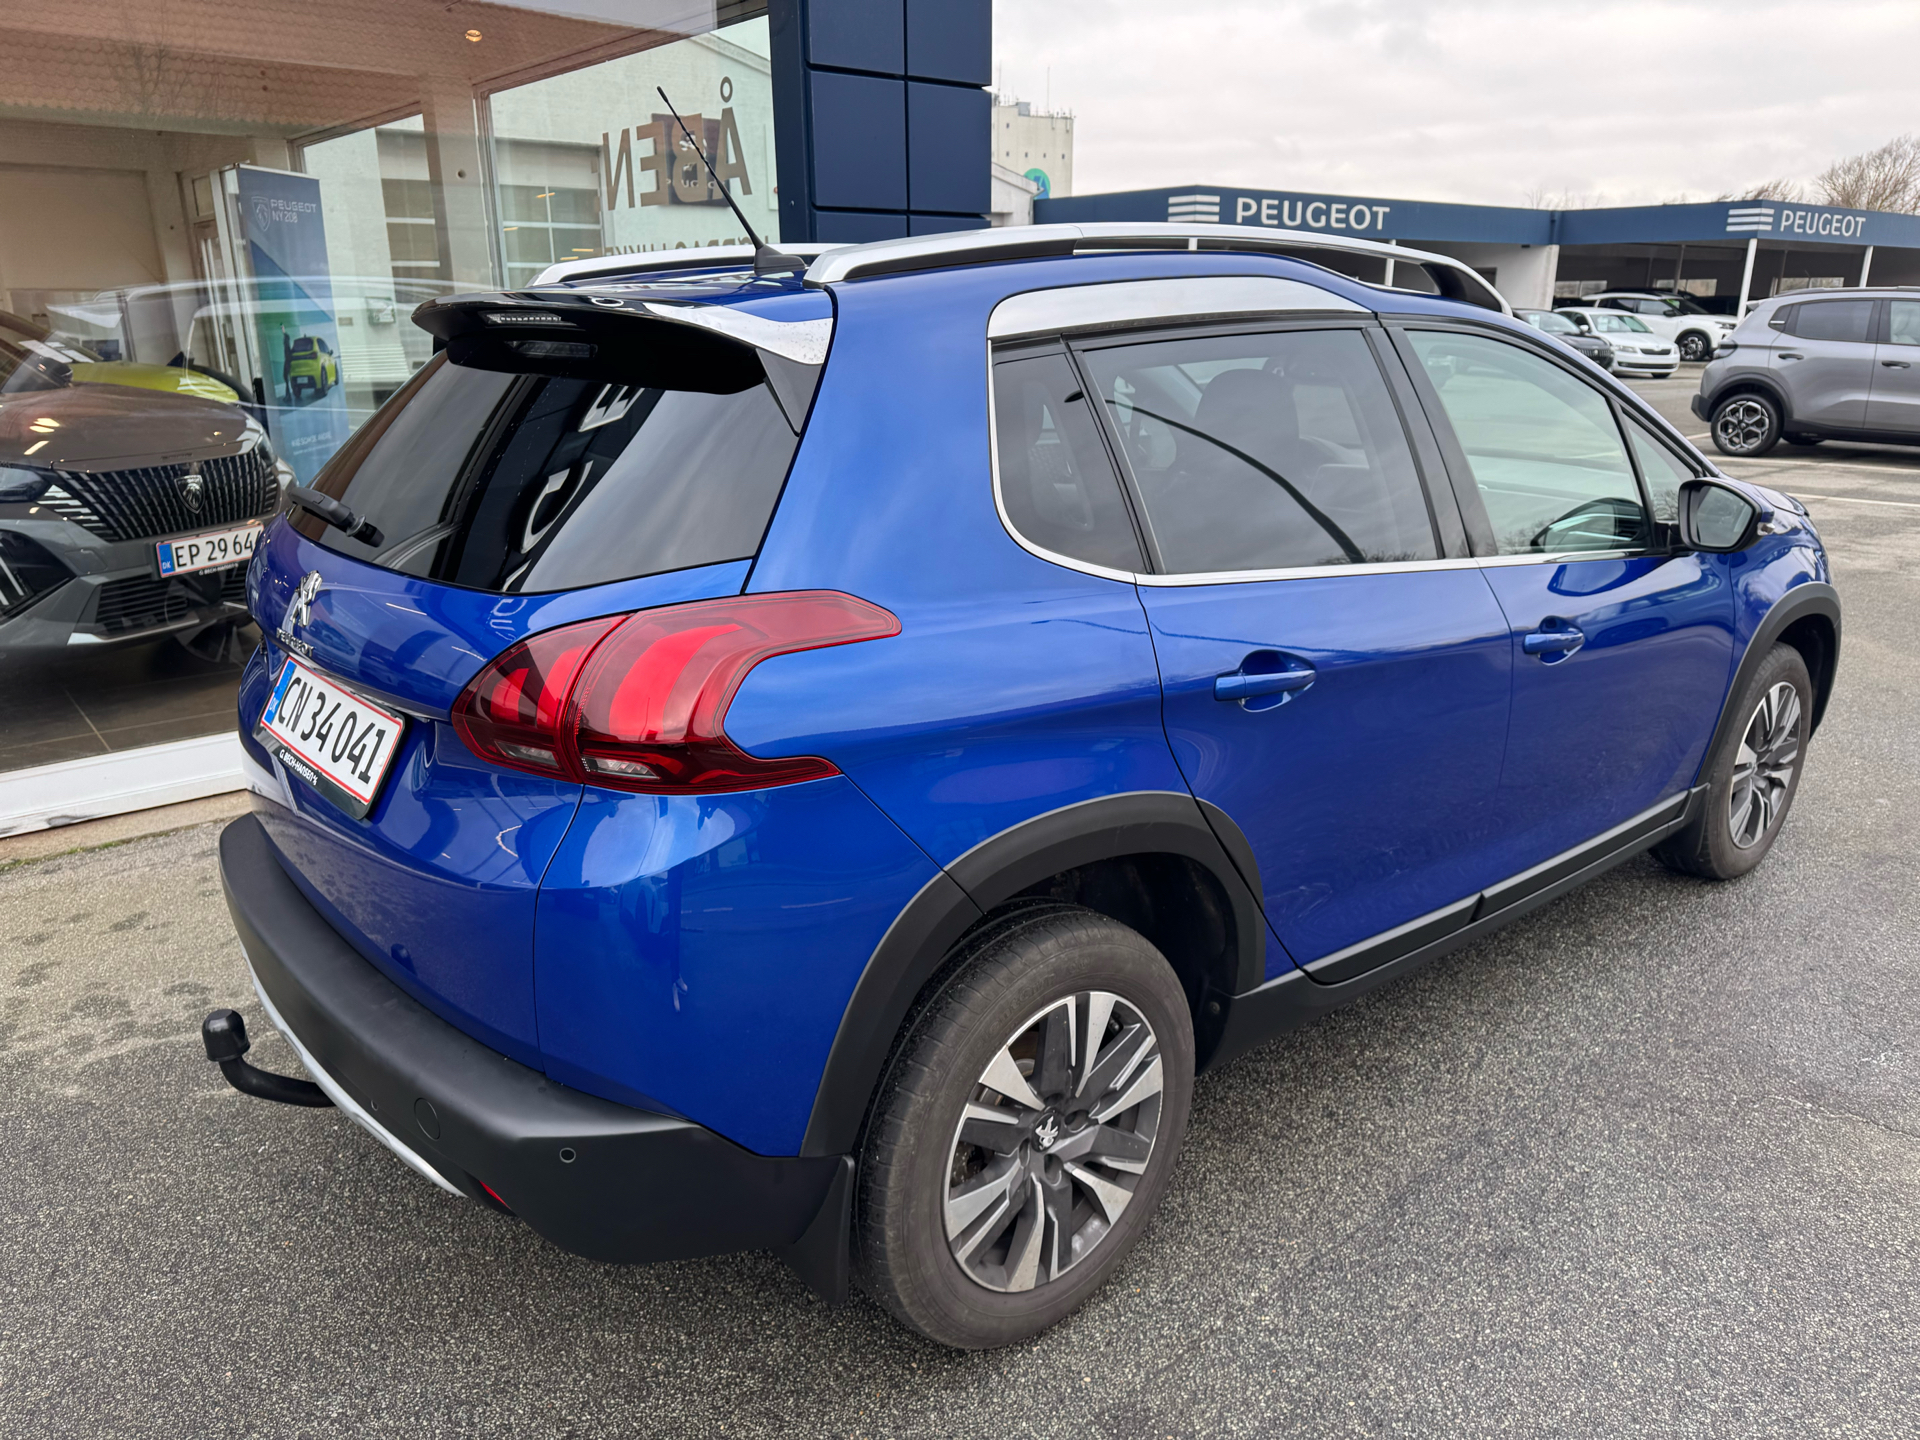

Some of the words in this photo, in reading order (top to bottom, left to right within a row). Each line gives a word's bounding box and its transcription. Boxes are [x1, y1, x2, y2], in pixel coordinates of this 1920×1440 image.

[270, 199, 317, 213] PEUGEOT
[284, 211, 298, 223] 208
[1236, 197, 1391, 230] PEUGEOT
[1779, 209, 1867, 238] PEUGEOT
[162, 561, 171, 570] DK
[174, 543, 200, 568] EP
[205, 538, 228, 562] 29
[278, 676, 314, 733] CN
[300, 691, 342, 753] 34
[331, 710, 387, 785] 041
